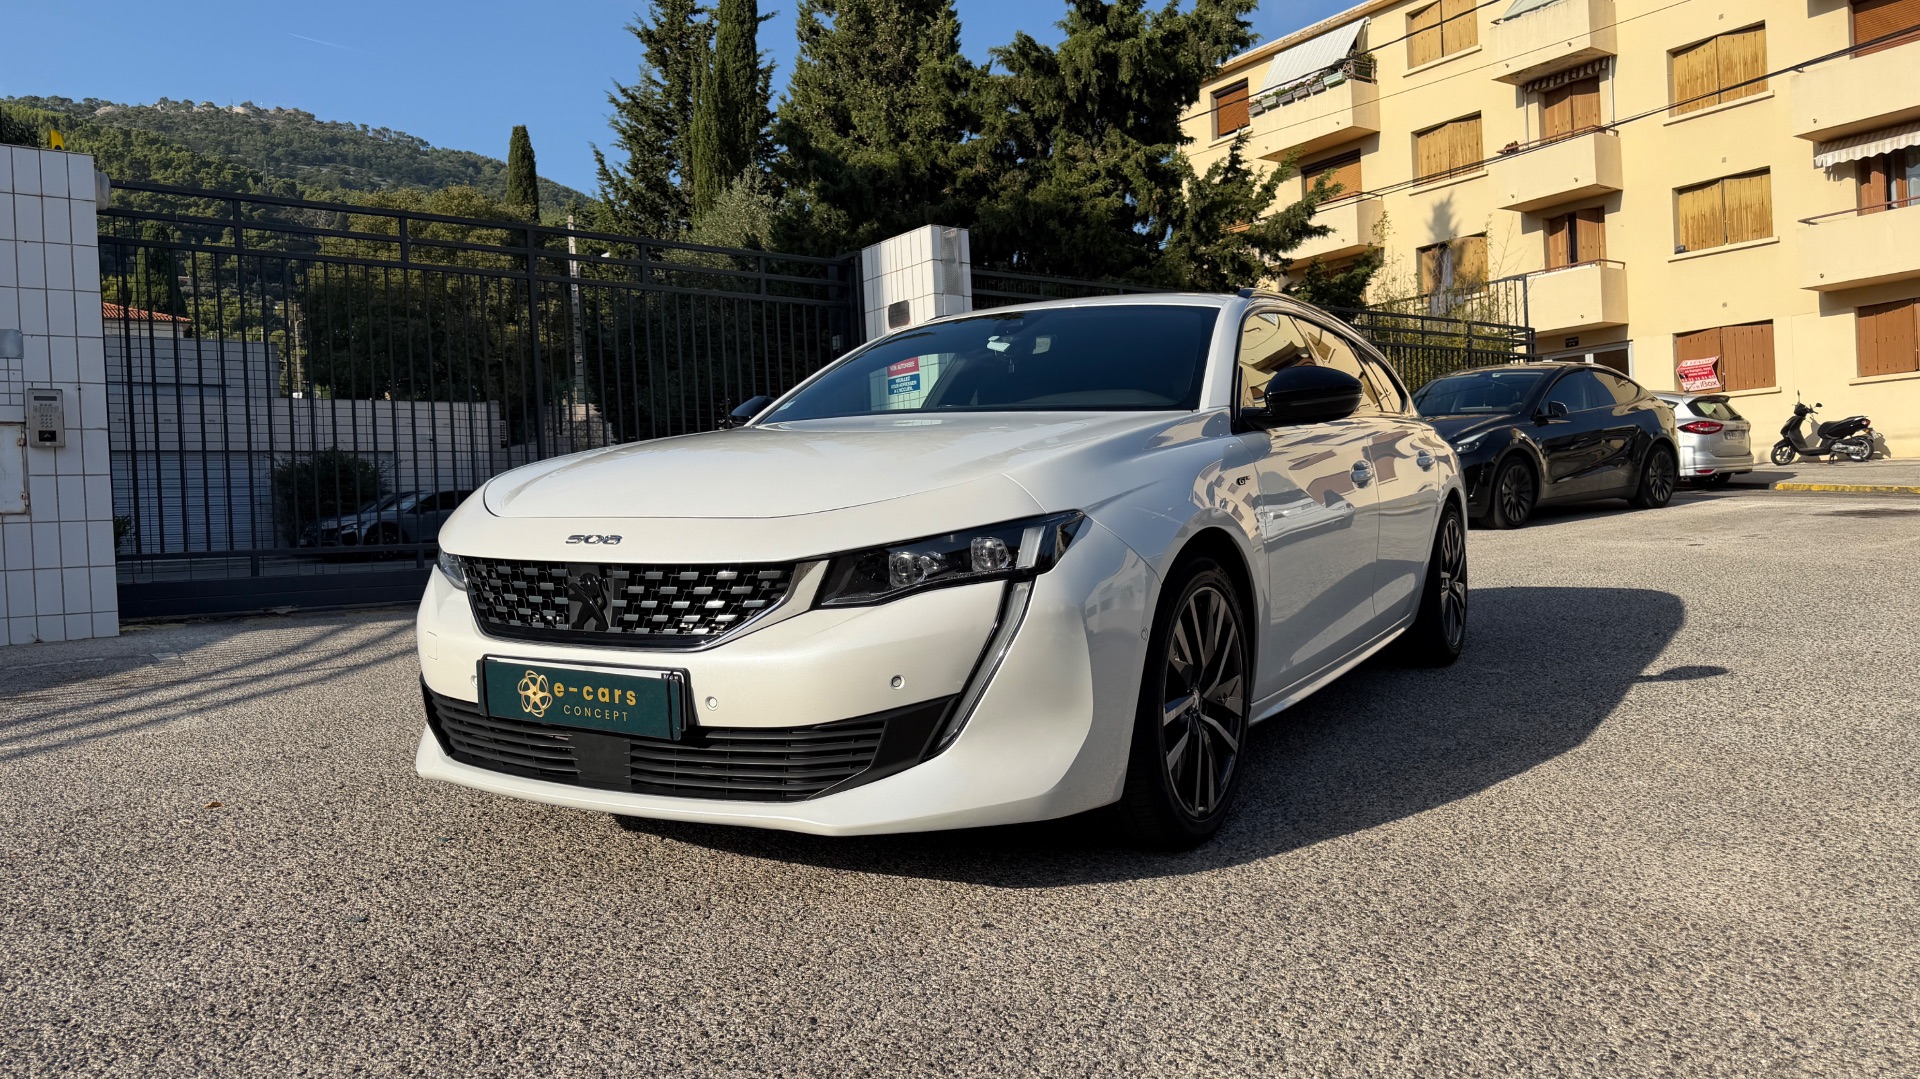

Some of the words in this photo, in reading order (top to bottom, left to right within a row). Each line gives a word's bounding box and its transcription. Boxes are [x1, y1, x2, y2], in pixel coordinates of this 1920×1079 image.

[565, 534, 623, 545] 508
[553, 680, 637, 706] e-cars
[563, 704, 628, 722] CONCEPT
